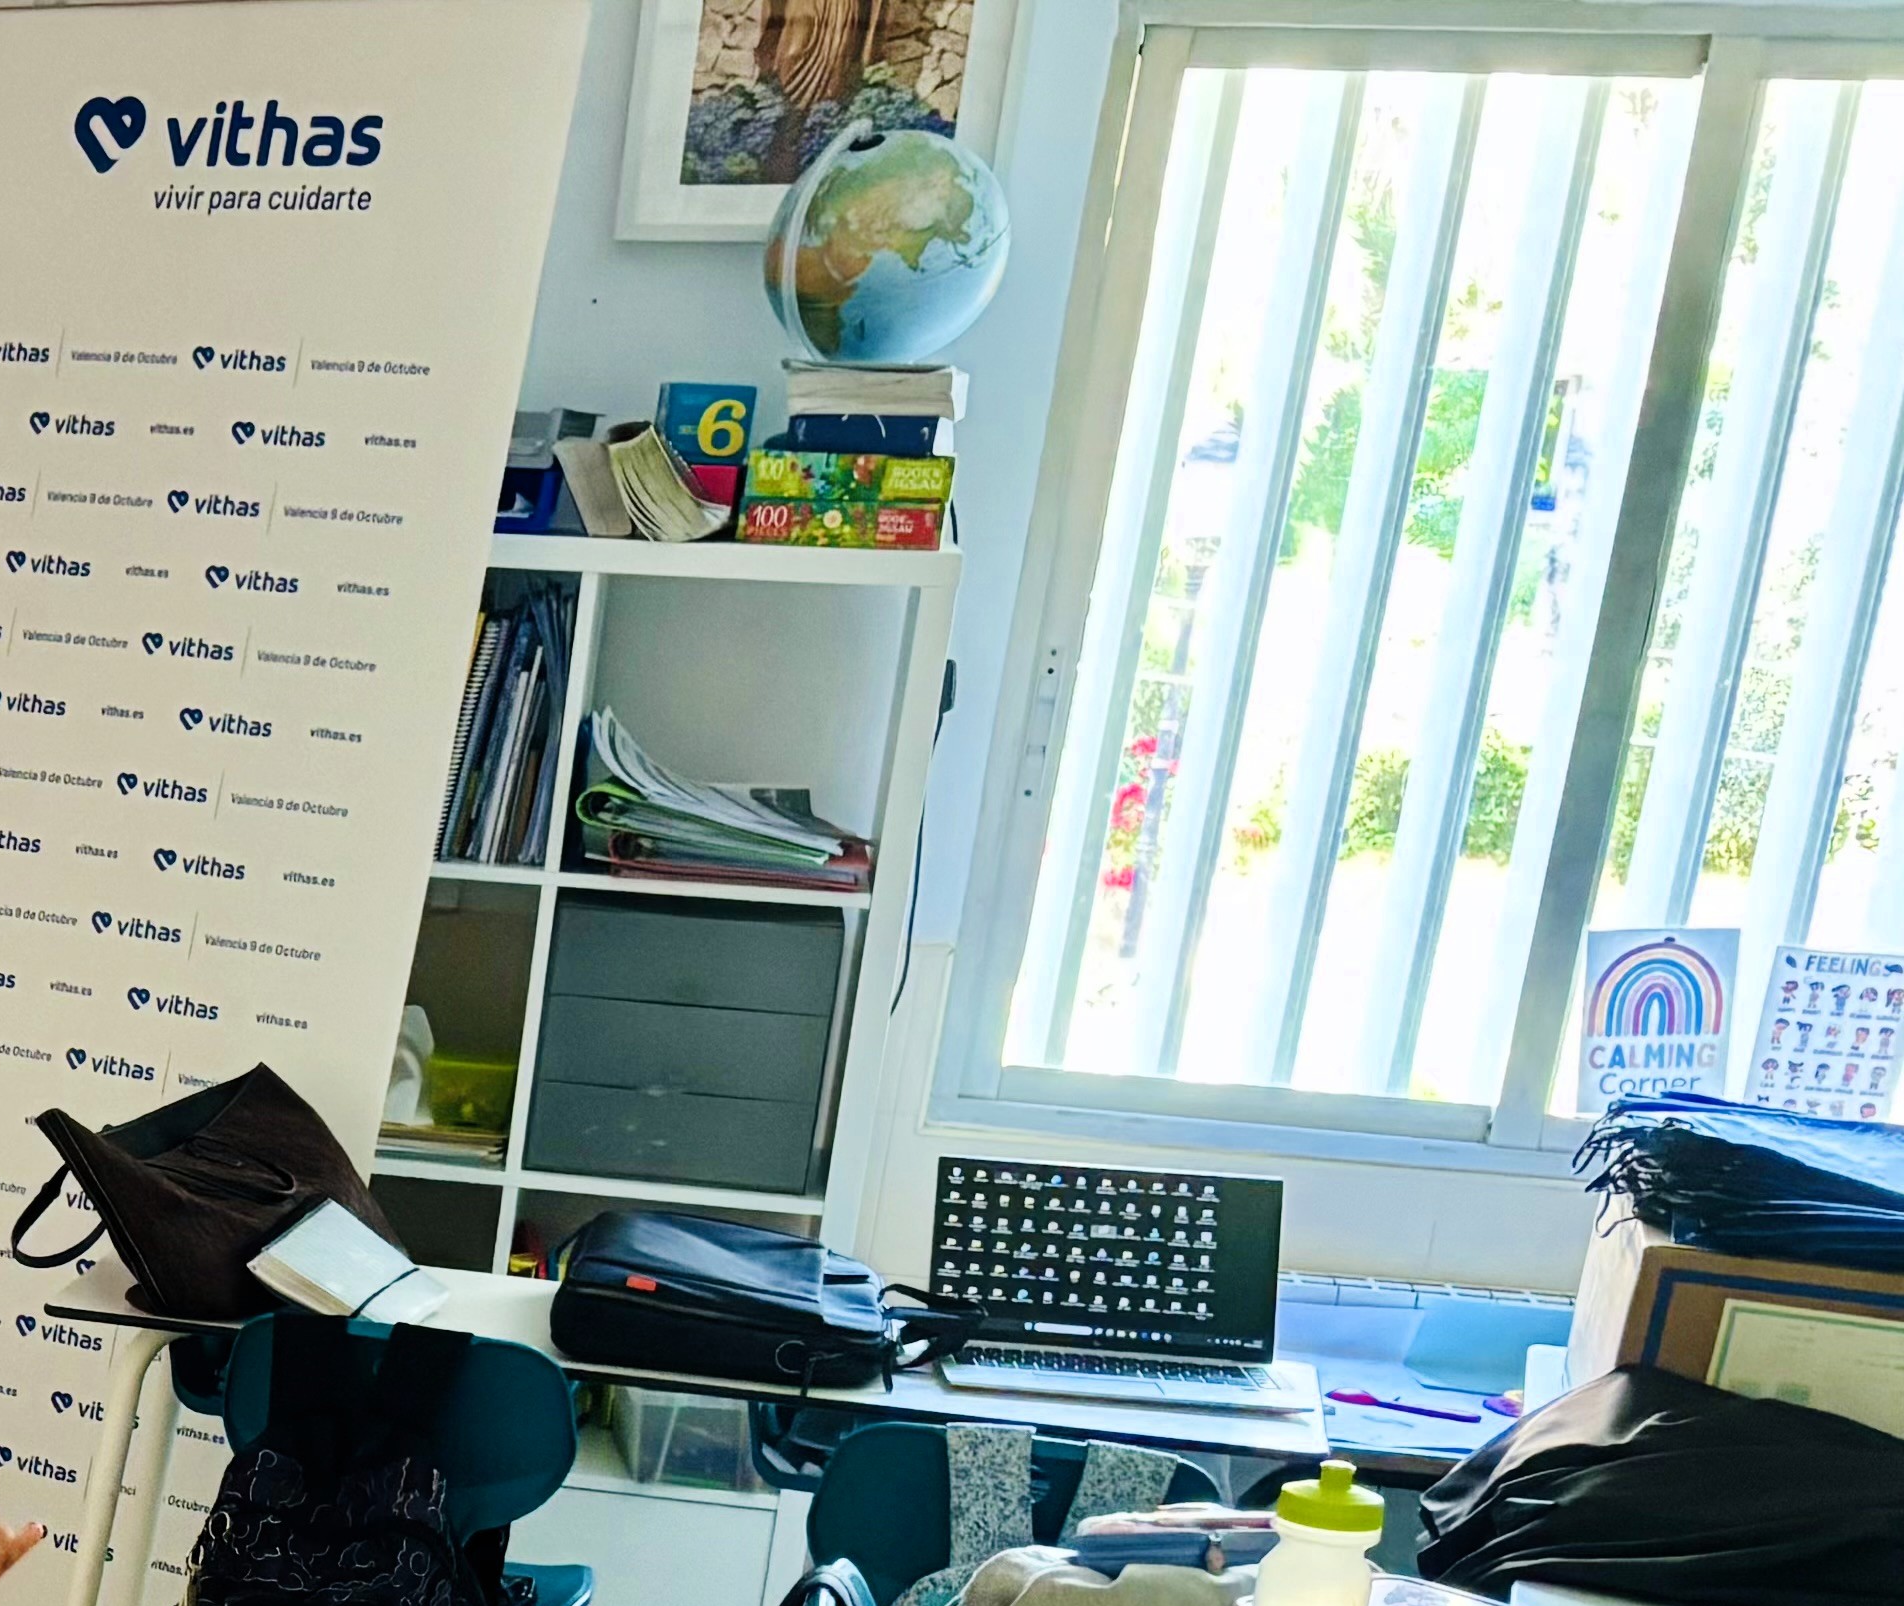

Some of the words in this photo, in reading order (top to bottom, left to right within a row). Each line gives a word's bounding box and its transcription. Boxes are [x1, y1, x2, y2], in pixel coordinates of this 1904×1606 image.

[167, 99, 383, 168] vithas
[153, 185, 205, 211] vivir
[208, 189, 261, 215] para
[268, 184, 373, 211] cuidarte
[220, 349, 286, 372] vithas
[55, 414, 115, 436] vithas
[261, 425, 325, 447] vithas
[698, 399, 746, 457] 6
[195, 494, 260, 517] vithas
[752, 505, 789, 527] 100
[31, 555, 90, 577] vithas
[235, 570, 299, 593] vithas
[169, 637, 234, 661] vithas
[7, 693, 66, 716] vithas
[209, 713, 272, 737] vithas
[143, 778, 207, 803] vithas
[183, 855, 245, 880] vithas
[117, 918, 181, 943] vithas
[156, 995, 219, 1020] vithas
[1589, 1043, 1717, 1070] CALMING
[92, 1055, 155, 1081] vithas
[178, 1072, 219, 1088] Valenci
[1598, 1071, 1702, 1095] Corner
[41, 1322, 103, 1352] vithas
[17, 1456, 77, 1483] vithas
